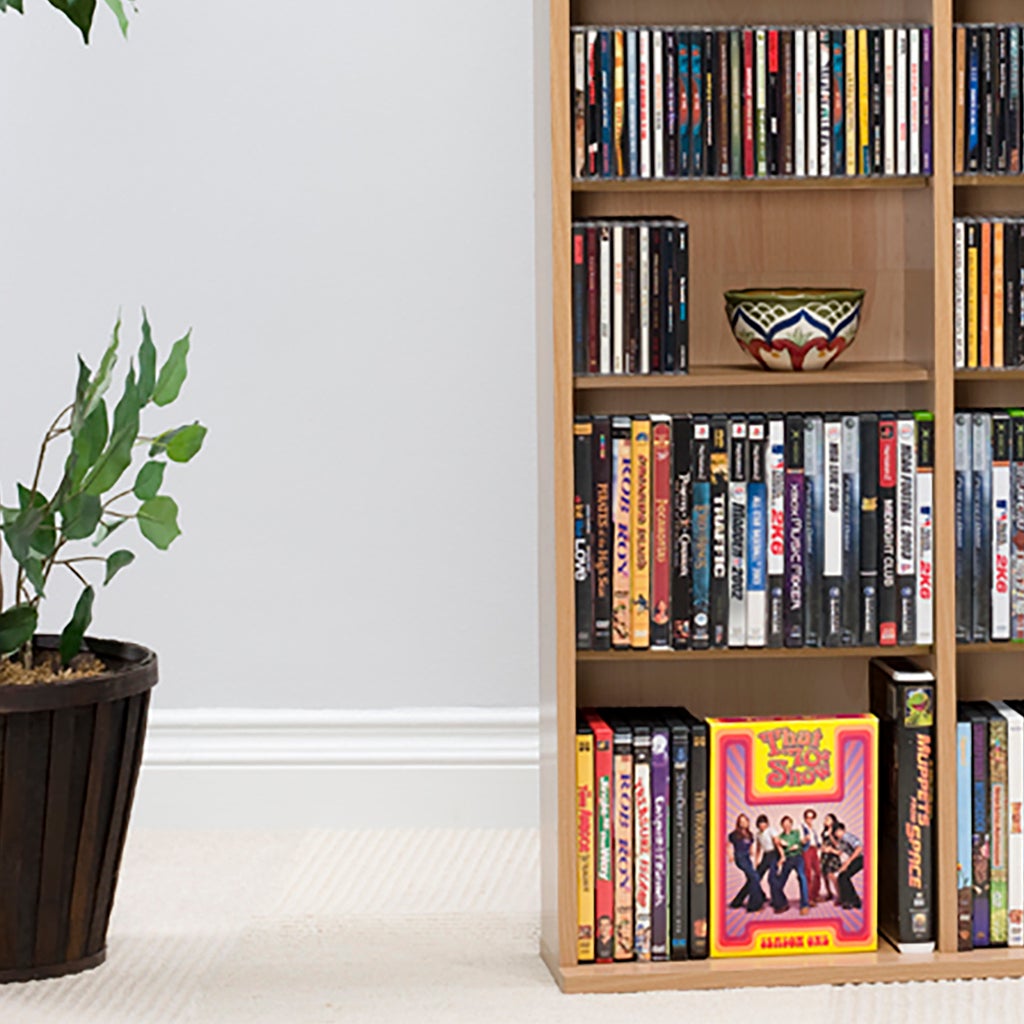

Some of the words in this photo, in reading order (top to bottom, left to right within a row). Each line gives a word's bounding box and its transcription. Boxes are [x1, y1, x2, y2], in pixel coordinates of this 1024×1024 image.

[713, 493, 725, 577] TRAFFIC
[771, 508, 784, 555] 2K6
[920, 560, 931, 600] 2K6
[996, 554, 1007, 593] 2K6
[758, 727, 823, 757] That
[766, 757, 831, 788] Show
[916, 734, 931, 827] MUPPETS
[619, 839, 631, 889] ROY
[905, 822, 922, 890] SPACE
